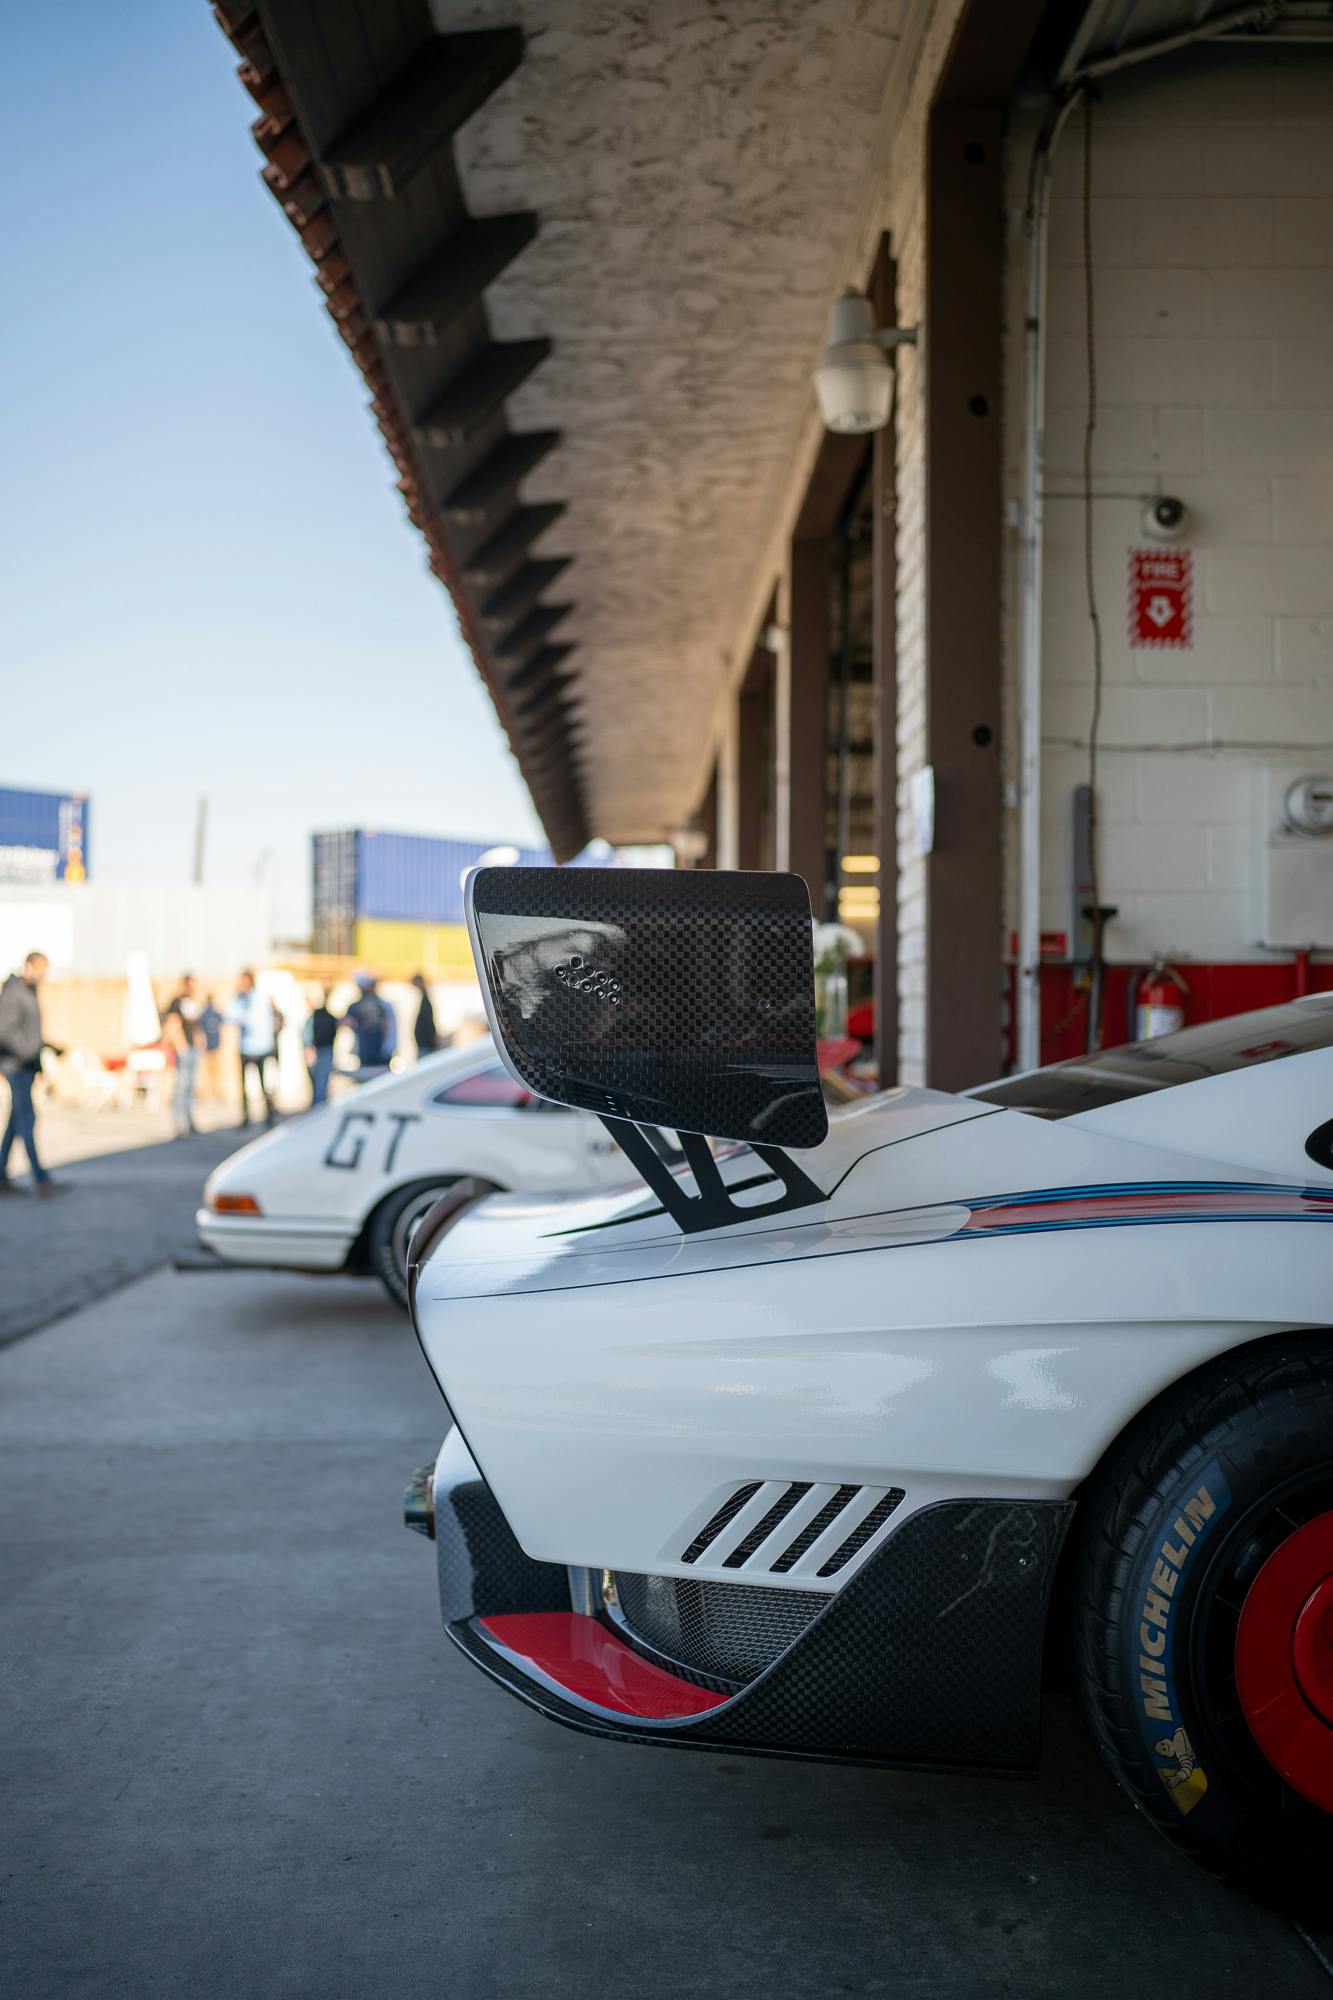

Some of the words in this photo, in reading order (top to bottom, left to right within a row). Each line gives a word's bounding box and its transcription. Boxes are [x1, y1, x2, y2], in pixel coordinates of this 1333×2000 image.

[1141, 560, 1179, 578] FIRE
[324, 1112, 421, 1174] GT
[1140, 1485, 1217, 1722] MICHELIN
